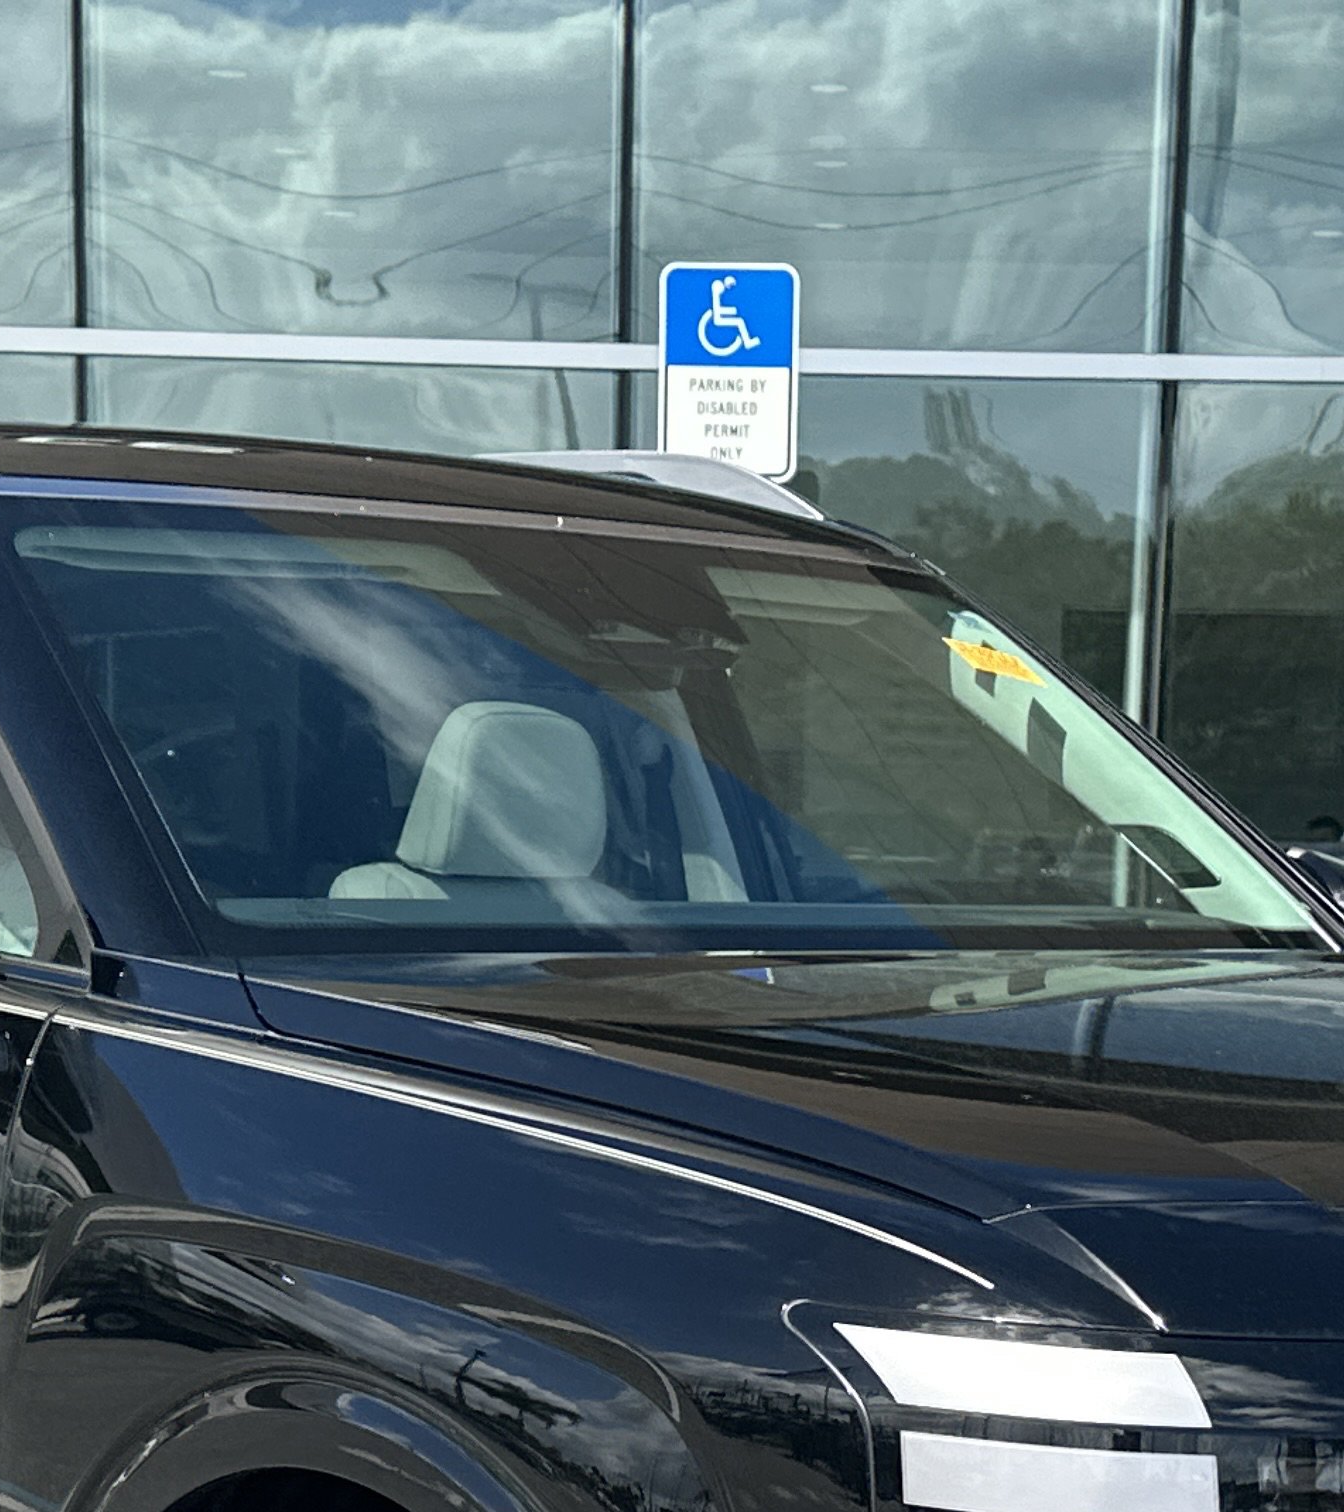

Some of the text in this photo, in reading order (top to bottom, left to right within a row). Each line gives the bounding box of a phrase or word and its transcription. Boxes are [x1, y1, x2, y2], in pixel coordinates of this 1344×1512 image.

[689, 378, 767, 393] PARKING BY
[697, 401, 758, 416] DISABLED
[704, 424, 750, 438] PERMIT
[711, 447, 742, 461] ONLY
